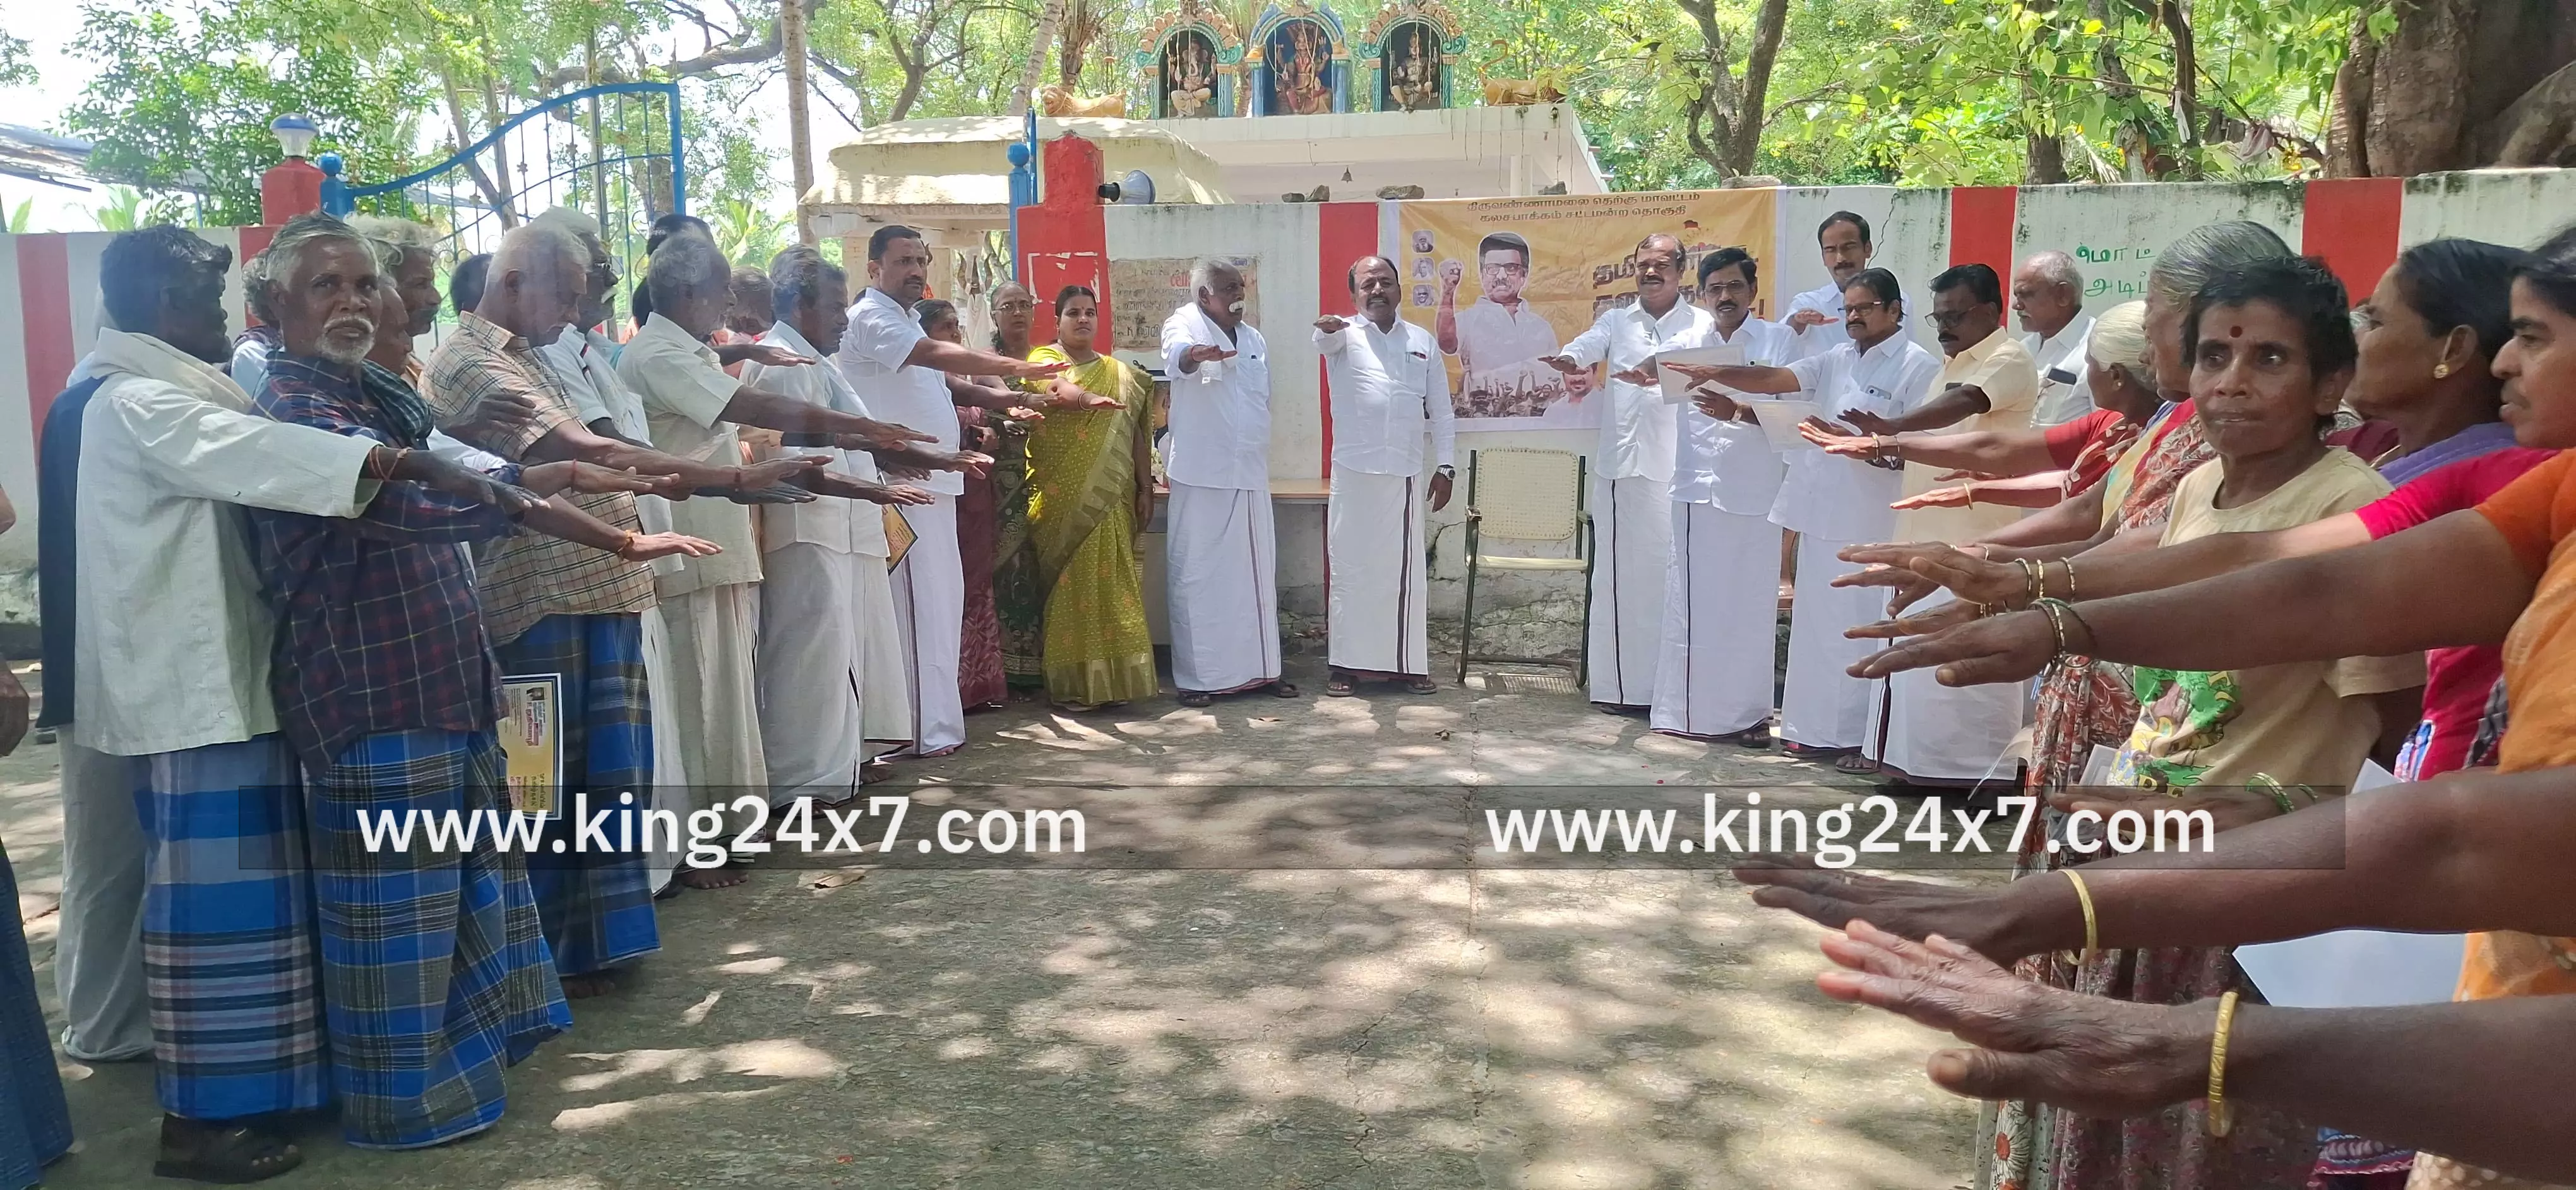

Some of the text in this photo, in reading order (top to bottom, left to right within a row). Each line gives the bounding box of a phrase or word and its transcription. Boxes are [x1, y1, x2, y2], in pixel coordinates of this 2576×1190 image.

[1467, 192, 1700, 212] திருவண்ணாமலை தெற்கு மாவட்டம்
[1479, 205, 1687, 222] கலசபாக்கம் சட்டமன்ற தொகுதி
